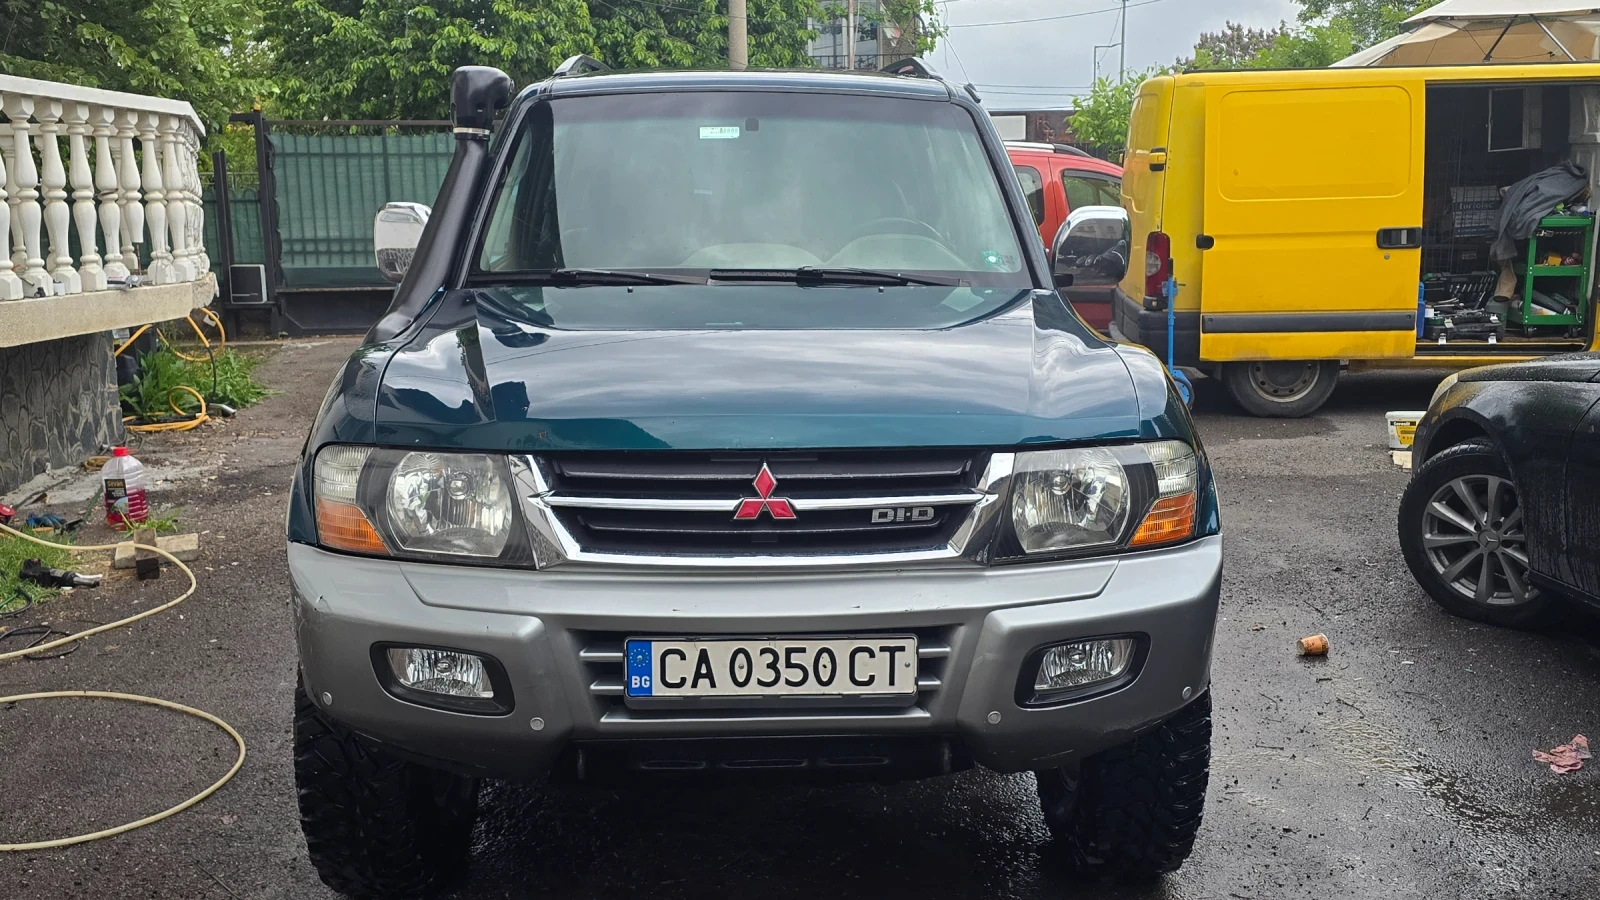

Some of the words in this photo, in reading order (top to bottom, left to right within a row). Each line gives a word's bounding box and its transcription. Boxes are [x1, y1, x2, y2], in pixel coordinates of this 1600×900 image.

[659, 648, 717, 689] CA
[729, 646, 837, 688] 0350
[848, 645, 906, 687] CT
[631, 675, 650, 688] BG
